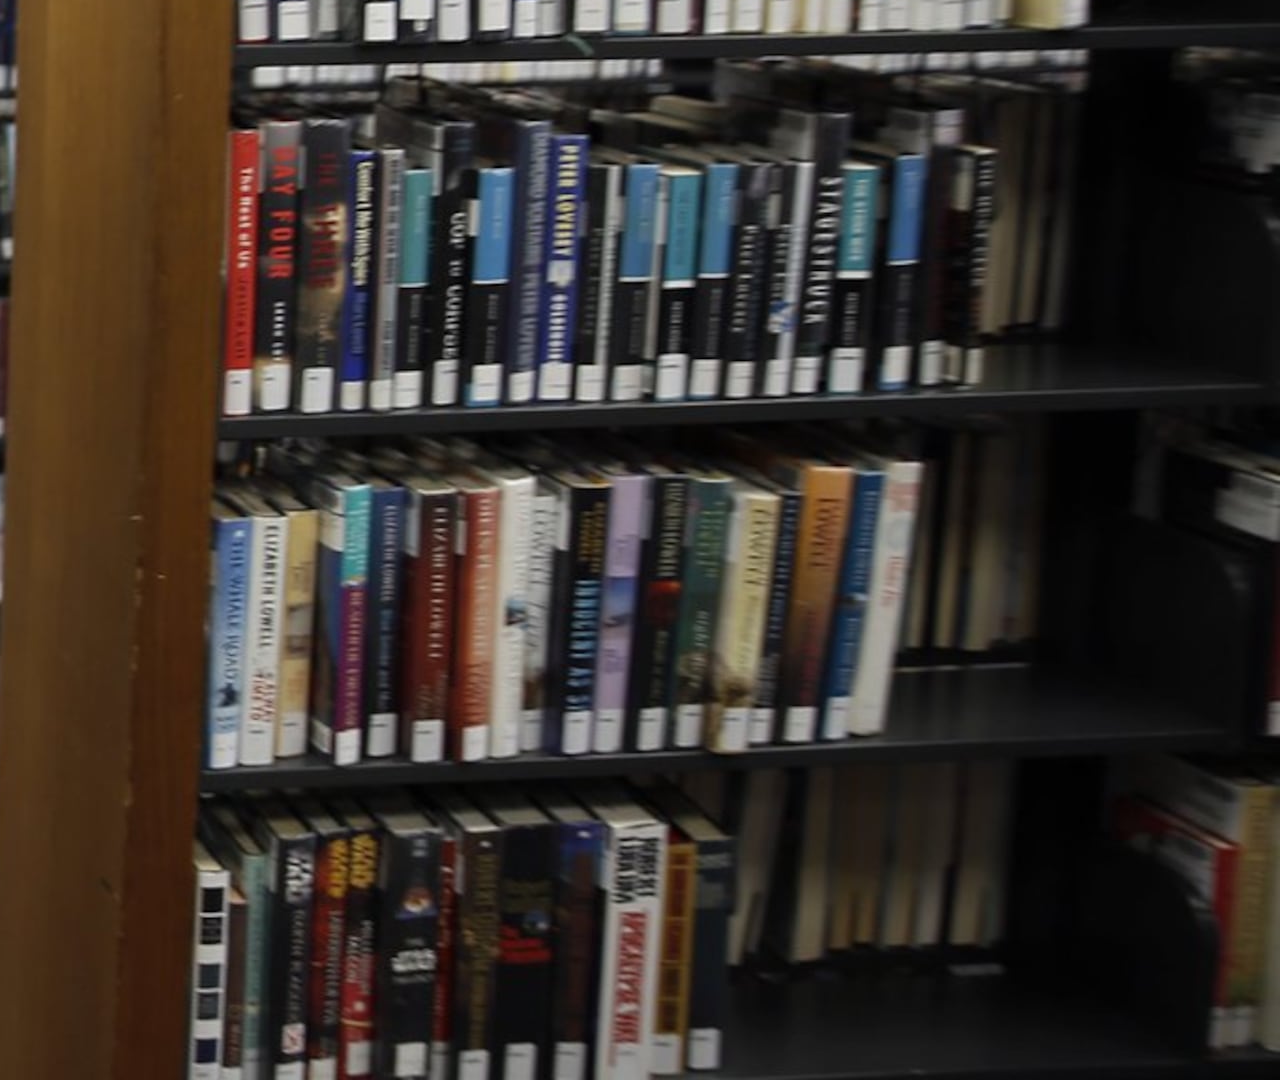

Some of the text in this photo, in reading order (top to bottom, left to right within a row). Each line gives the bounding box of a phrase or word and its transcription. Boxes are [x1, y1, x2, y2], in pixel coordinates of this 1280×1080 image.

[267, 210, 293, 279] FOUR
[260, 525, 279, 648] ELIZABETH LOWELL
